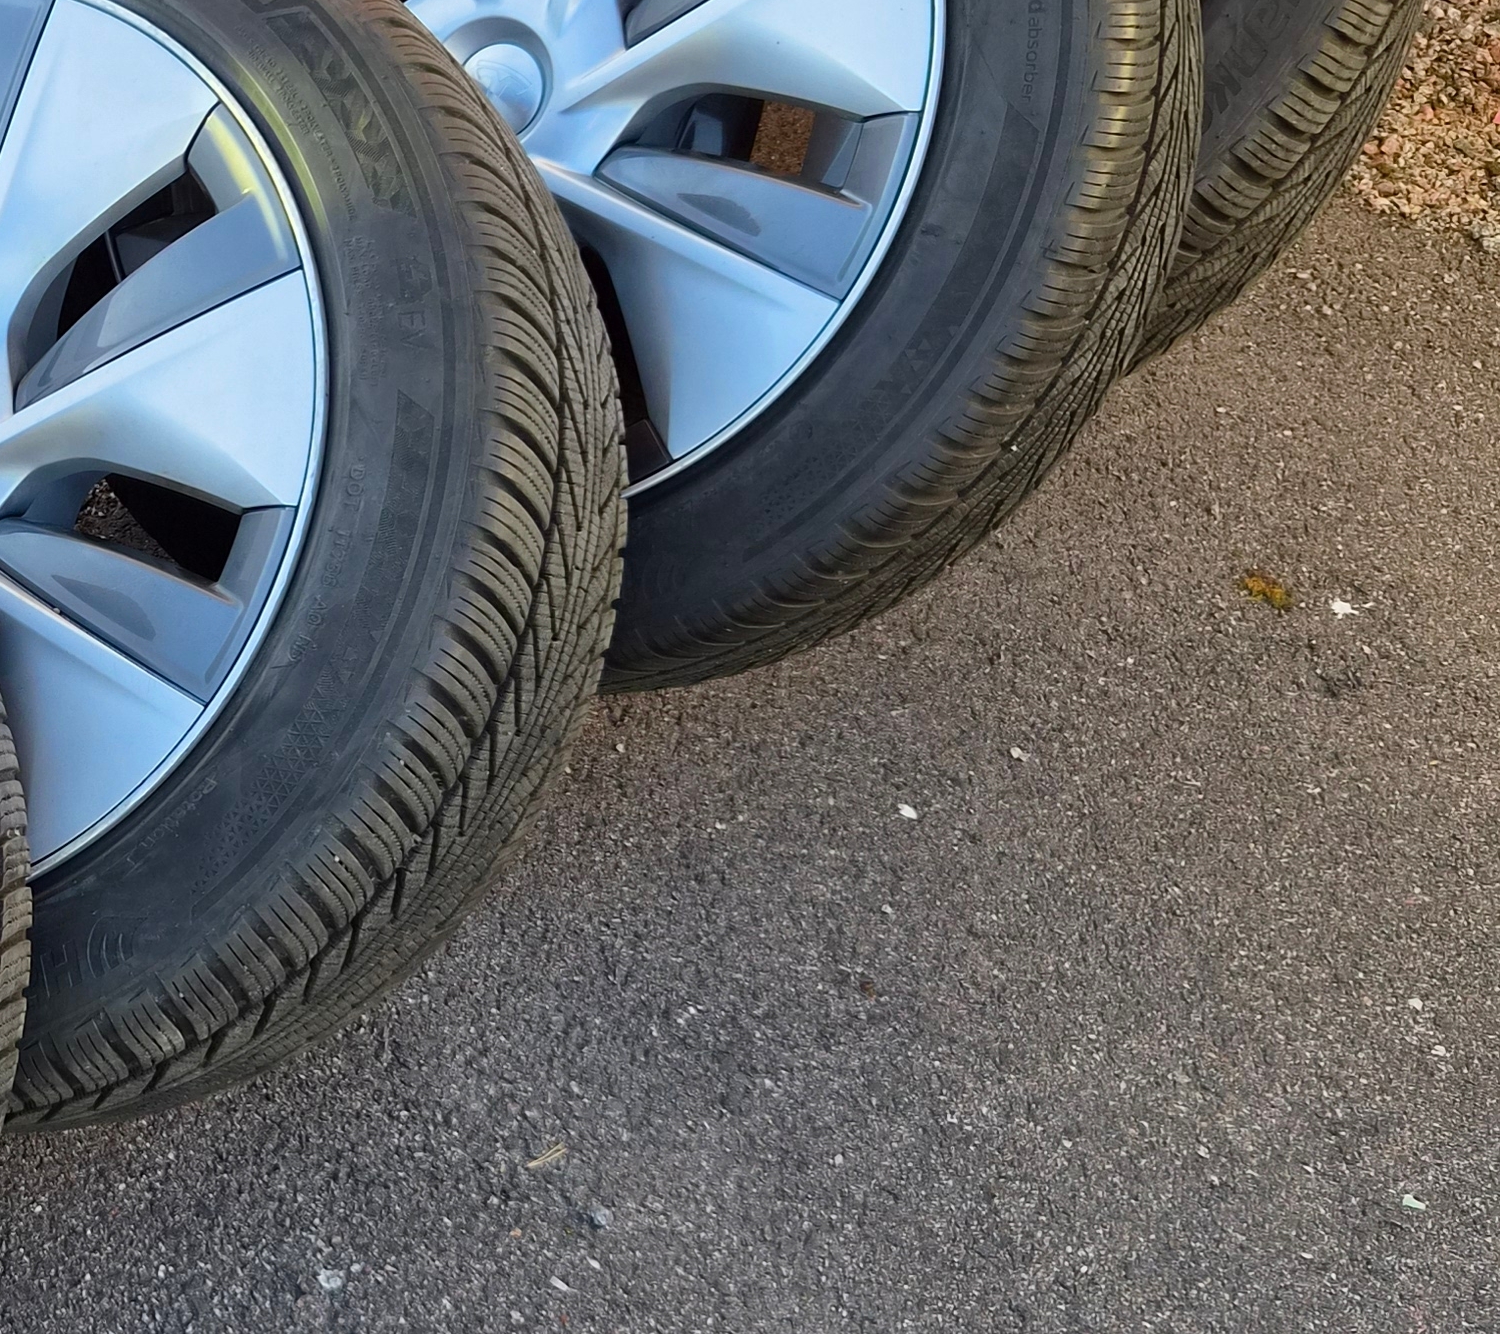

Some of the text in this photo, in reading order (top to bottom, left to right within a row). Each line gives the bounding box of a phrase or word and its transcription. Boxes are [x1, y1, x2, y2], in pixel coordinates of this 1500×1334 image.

[1019, 16, 1043, 102] absorber
[400, 308, 434, 351] EV
[339, 463, 369, 513] DOT
